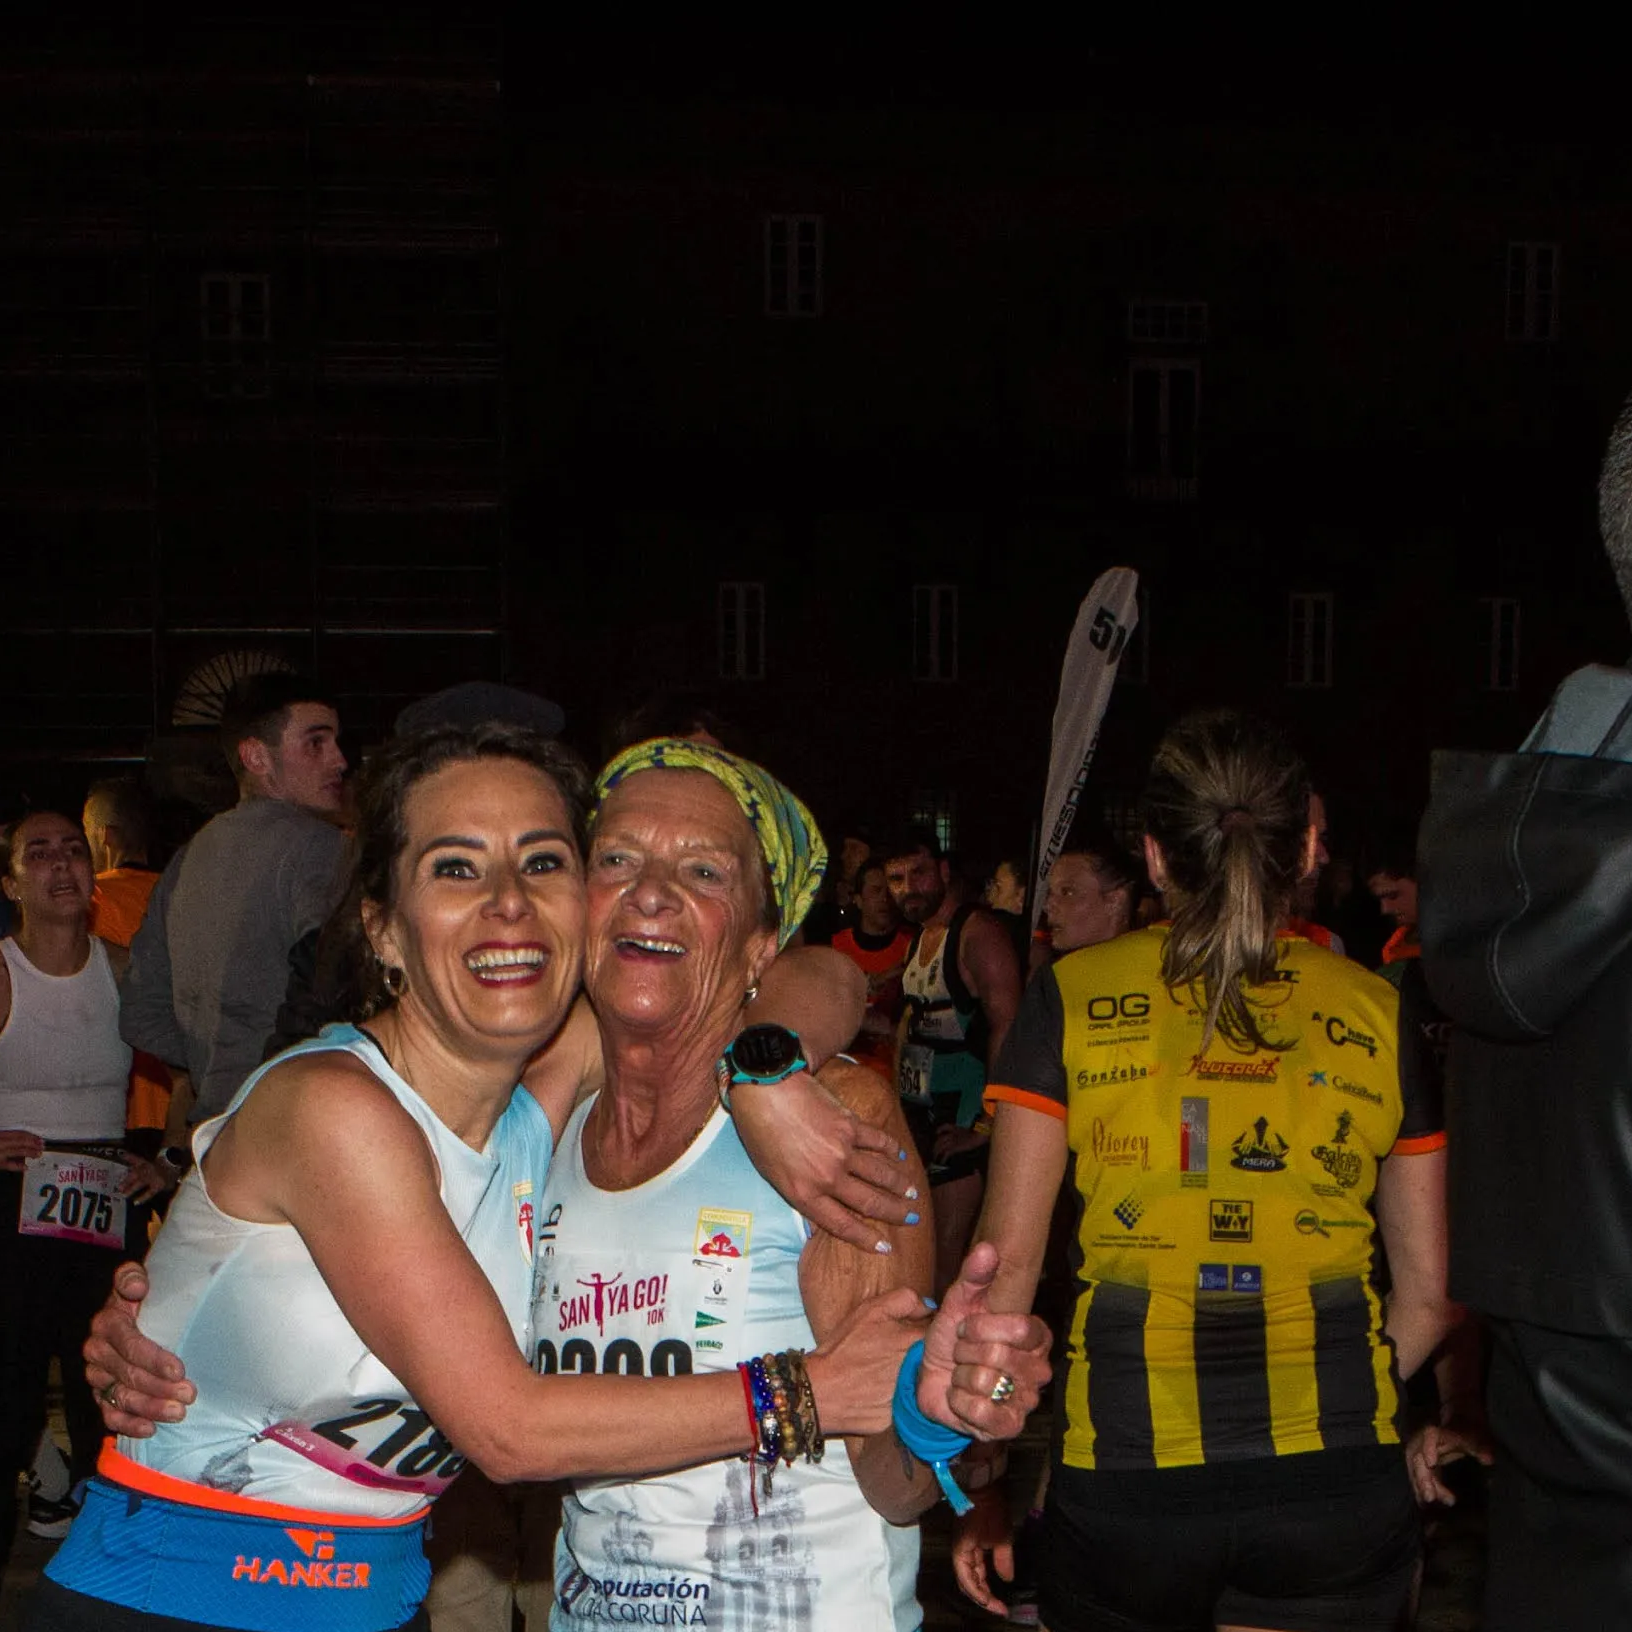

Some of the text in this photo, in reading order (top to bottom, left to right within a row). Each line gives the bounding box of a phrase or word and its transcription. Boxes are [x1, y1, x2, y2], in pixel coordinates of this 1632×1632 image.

[1088, 993, 1150, 1020] OG
[36, 1183, 113, 1234] 2075
[647, 1310, 664, 1326] 10K
[232, 1555, 371, 1588] HANKER
